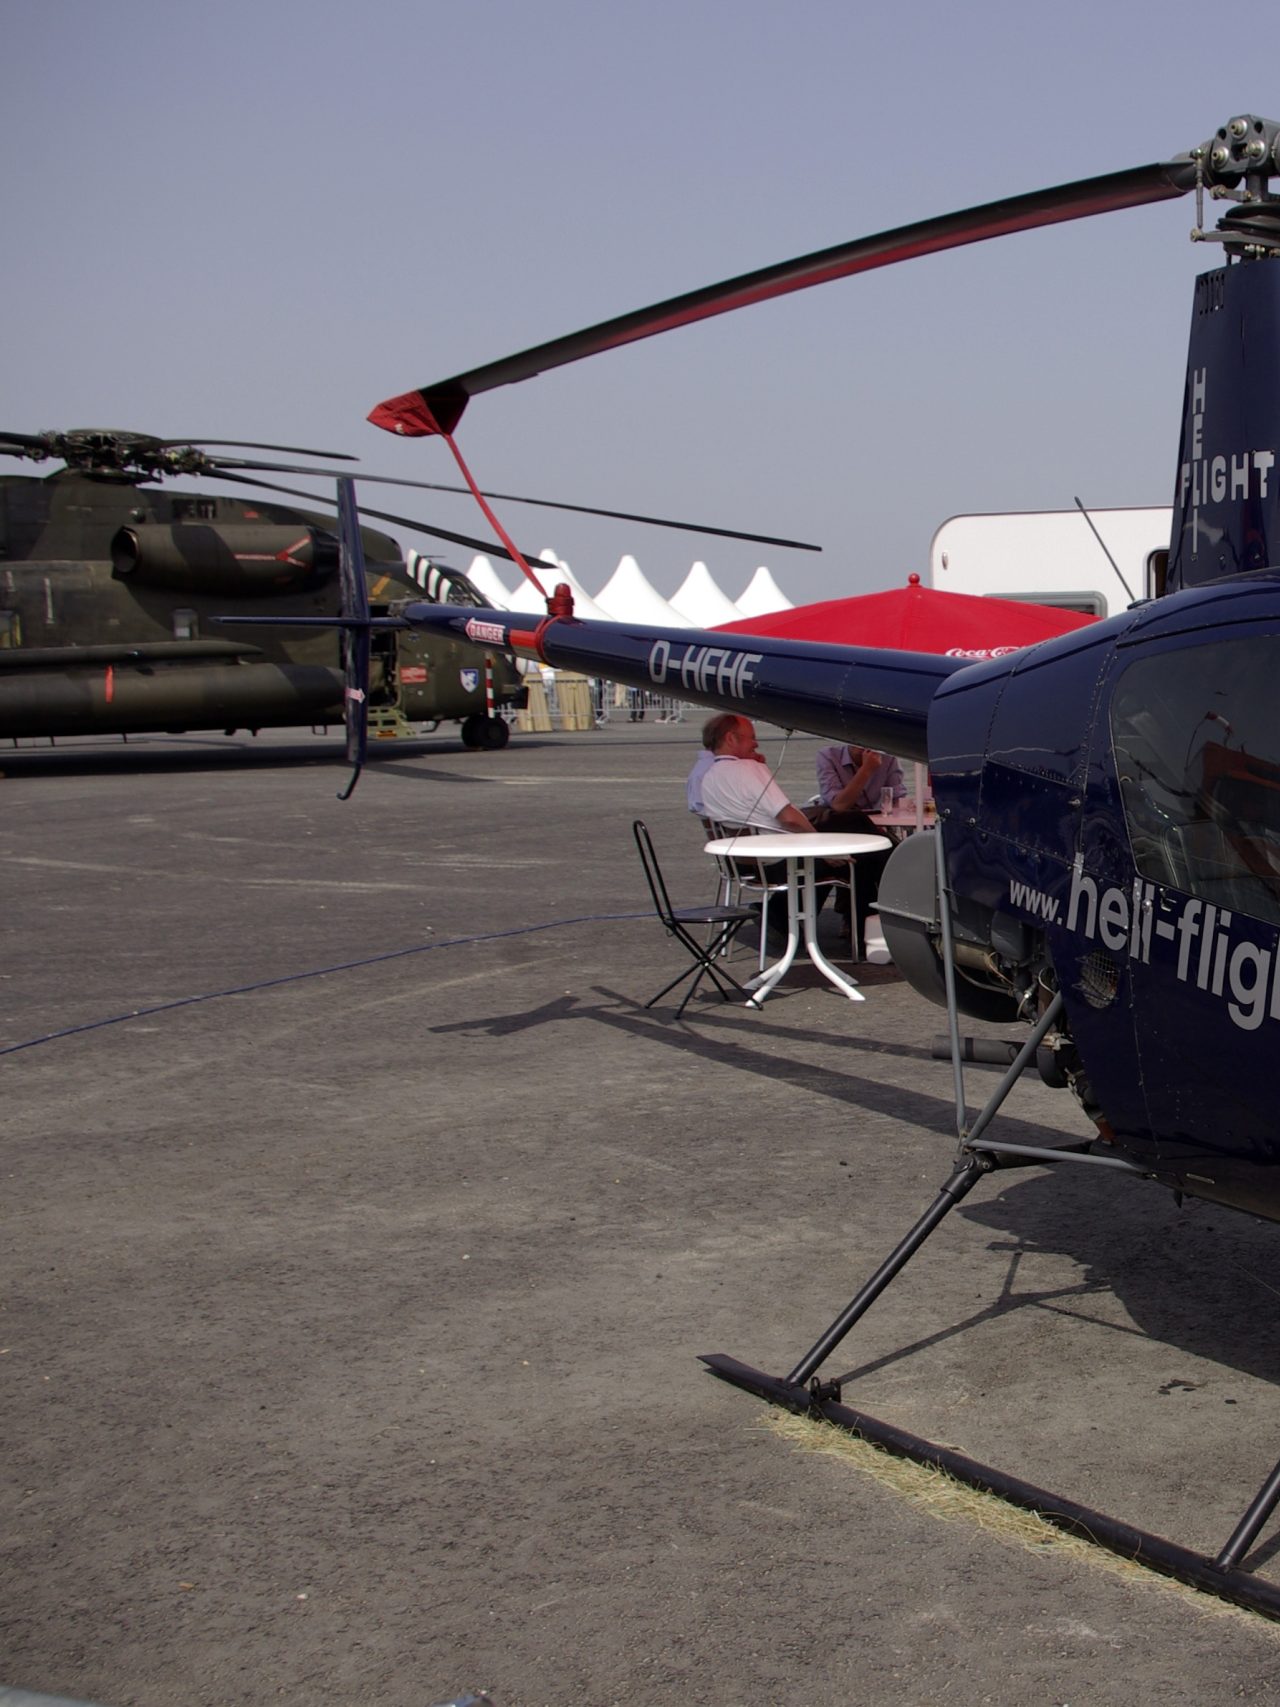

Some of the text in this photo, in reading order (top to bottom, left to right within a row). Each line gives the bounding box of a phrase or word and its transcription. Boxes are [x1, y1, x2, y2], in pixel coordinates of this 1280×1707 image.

[1180, 451, 1275, 509] FLIGHT
[1192, 367, 1207, 554] HELI
[469, 624, 504, 642] DANGER
